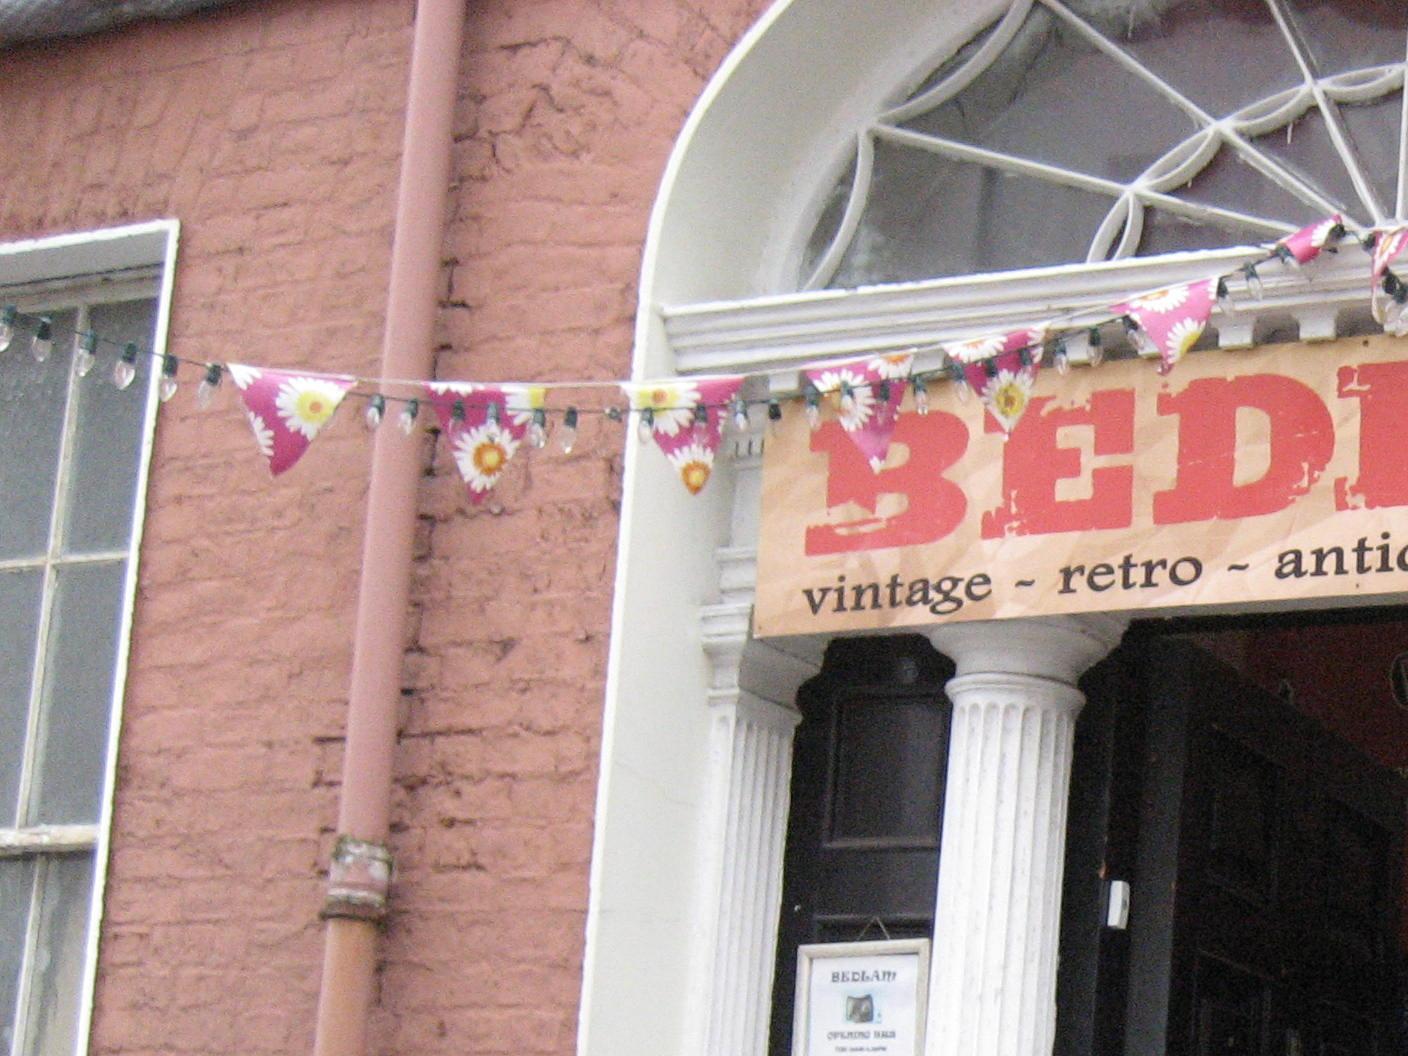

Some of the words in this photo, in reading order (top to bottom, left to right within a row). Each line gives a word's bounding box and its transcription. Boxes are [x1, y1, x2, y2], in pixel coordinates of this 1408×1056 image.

[802, 573, 993, 616] vintage
[1057, 553, 1204, 596] retro
[831, 969, 898, 984] BEDLAM
